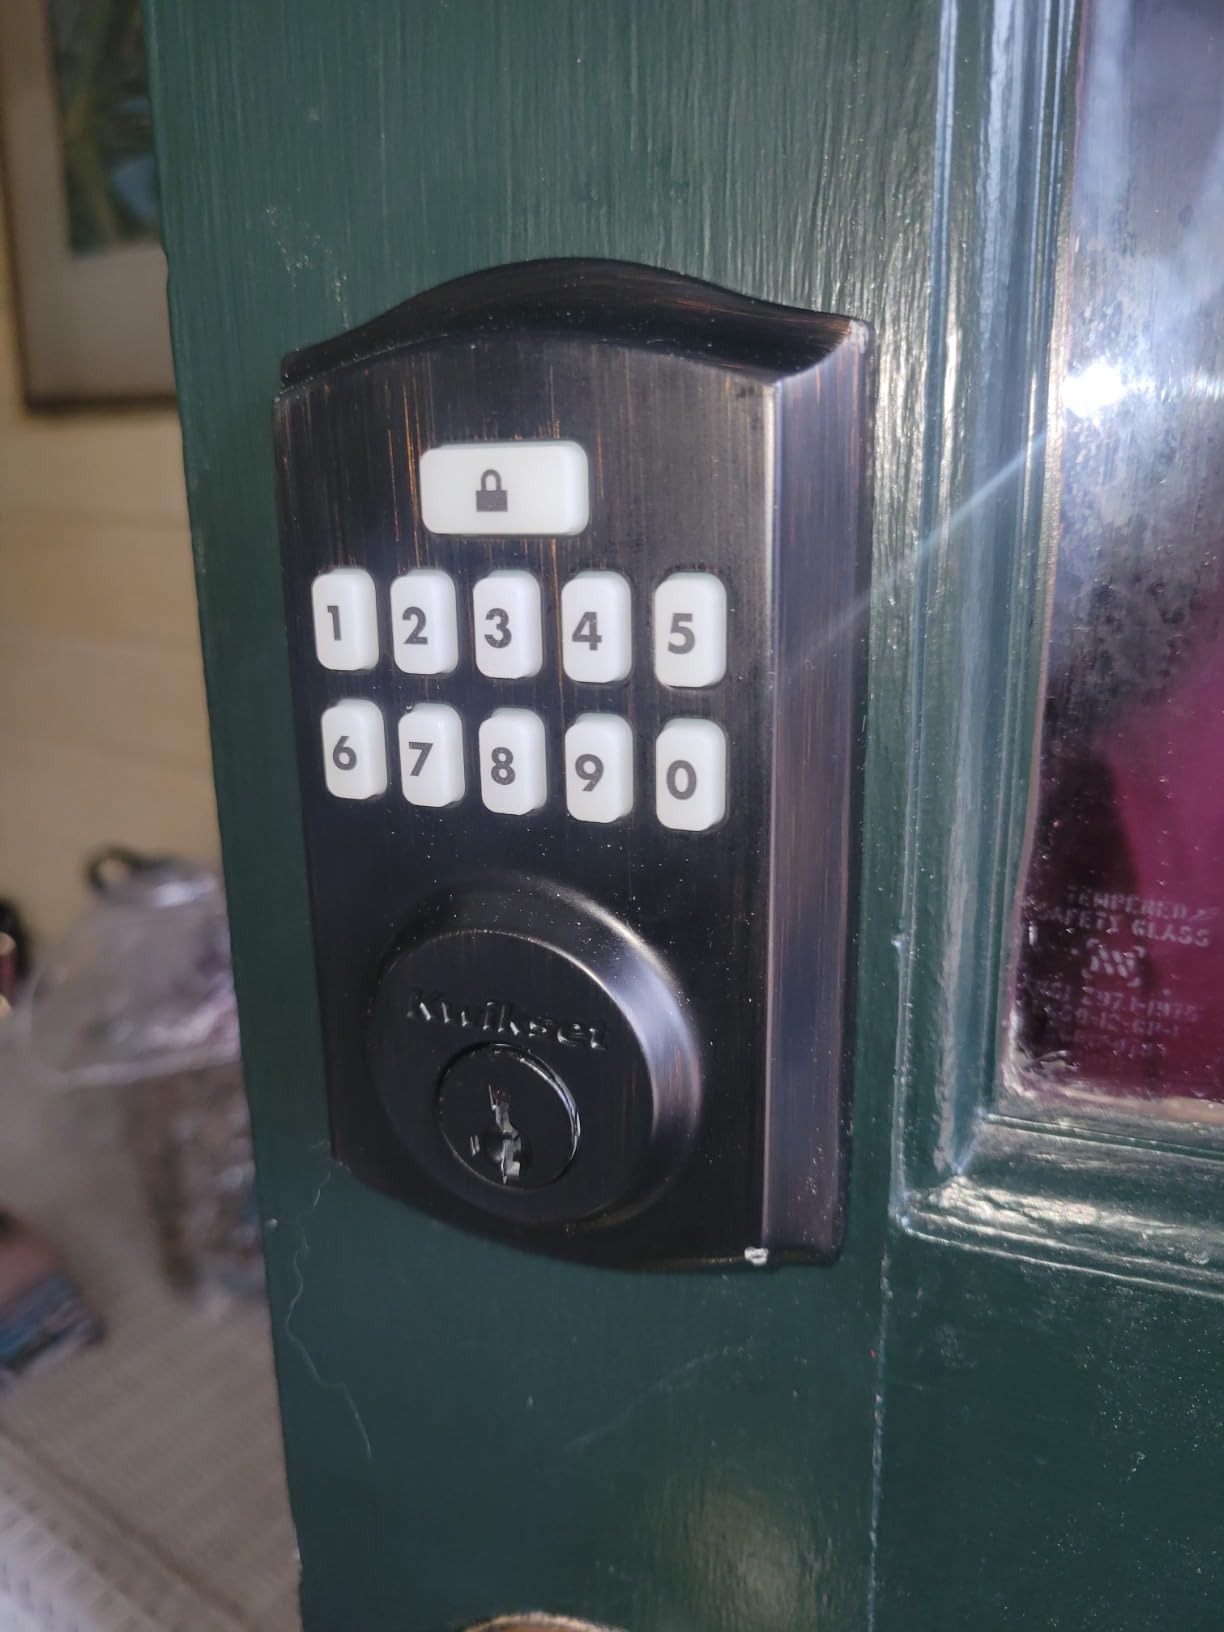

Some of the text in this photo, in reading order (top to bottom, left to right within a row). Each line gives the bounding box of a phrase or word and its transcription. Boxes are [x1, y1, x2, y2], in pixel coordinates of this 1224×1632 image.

[327, 606, 695, 654] 1 2 3 4 5
[333, 736, 696, 800] 6 7 8 9 0
[1066, 884, 1188, 919] TEMPERED
[1037, 905, 1210, 947] SAFETY GLASS
